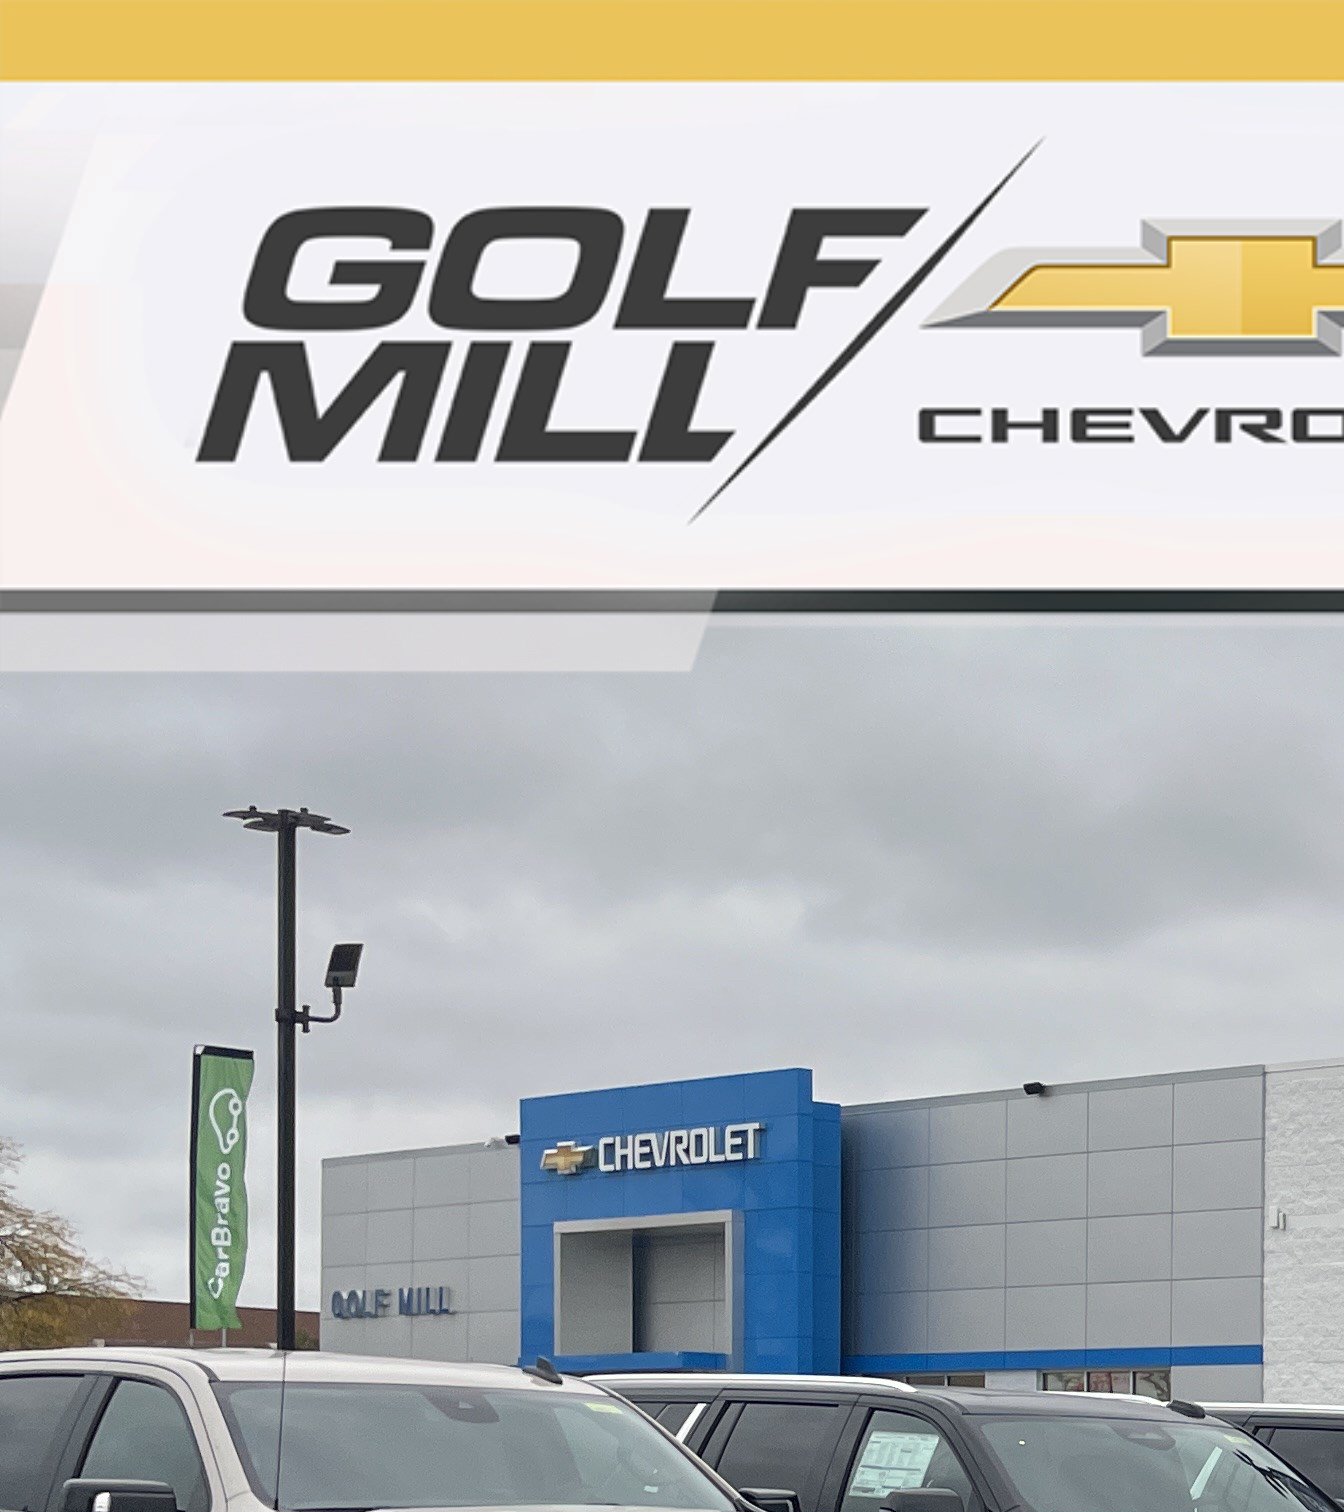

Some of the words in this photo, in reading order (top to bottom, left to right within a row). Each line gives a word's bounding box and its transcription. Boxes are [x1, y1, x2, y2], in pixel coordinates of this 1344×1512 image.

[599, 1122, 763, 1173] CHEVROLET
[207, 1162, 232, 1299] CarBravo
[399, 1286, 453, 1316] MILL
